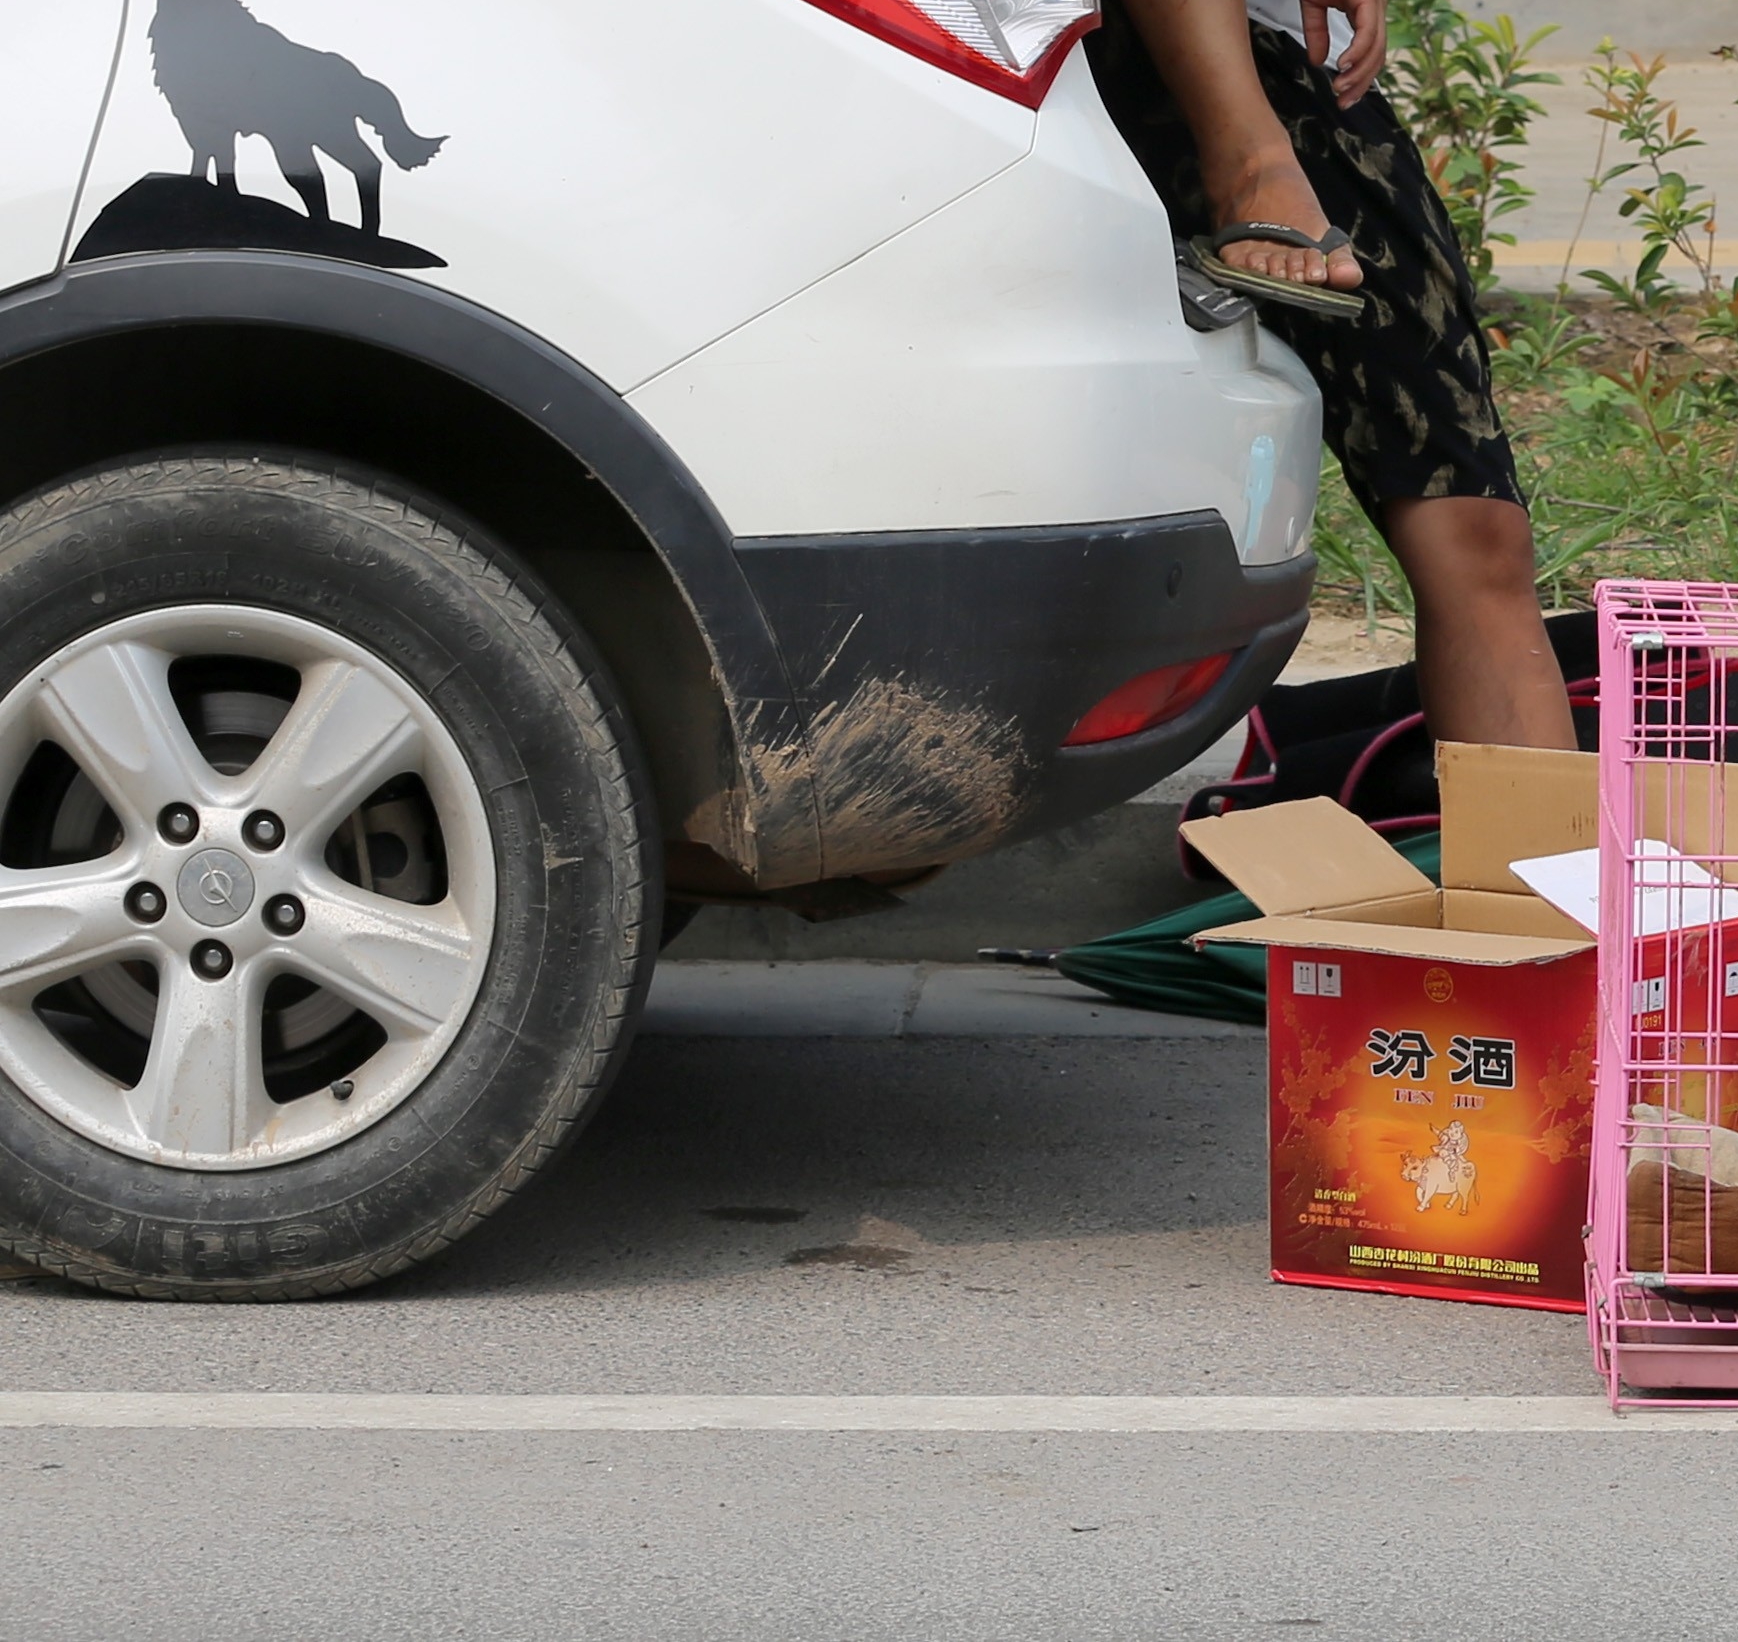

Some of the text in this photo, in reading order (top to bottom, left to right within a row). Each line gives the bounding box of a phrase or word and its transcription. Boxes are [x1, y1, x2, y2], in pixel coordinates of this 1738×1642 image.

[1365, 1027, 1517, 1090] 汾酒
[1393, 1088, 1486, 1110] FEN JIU
